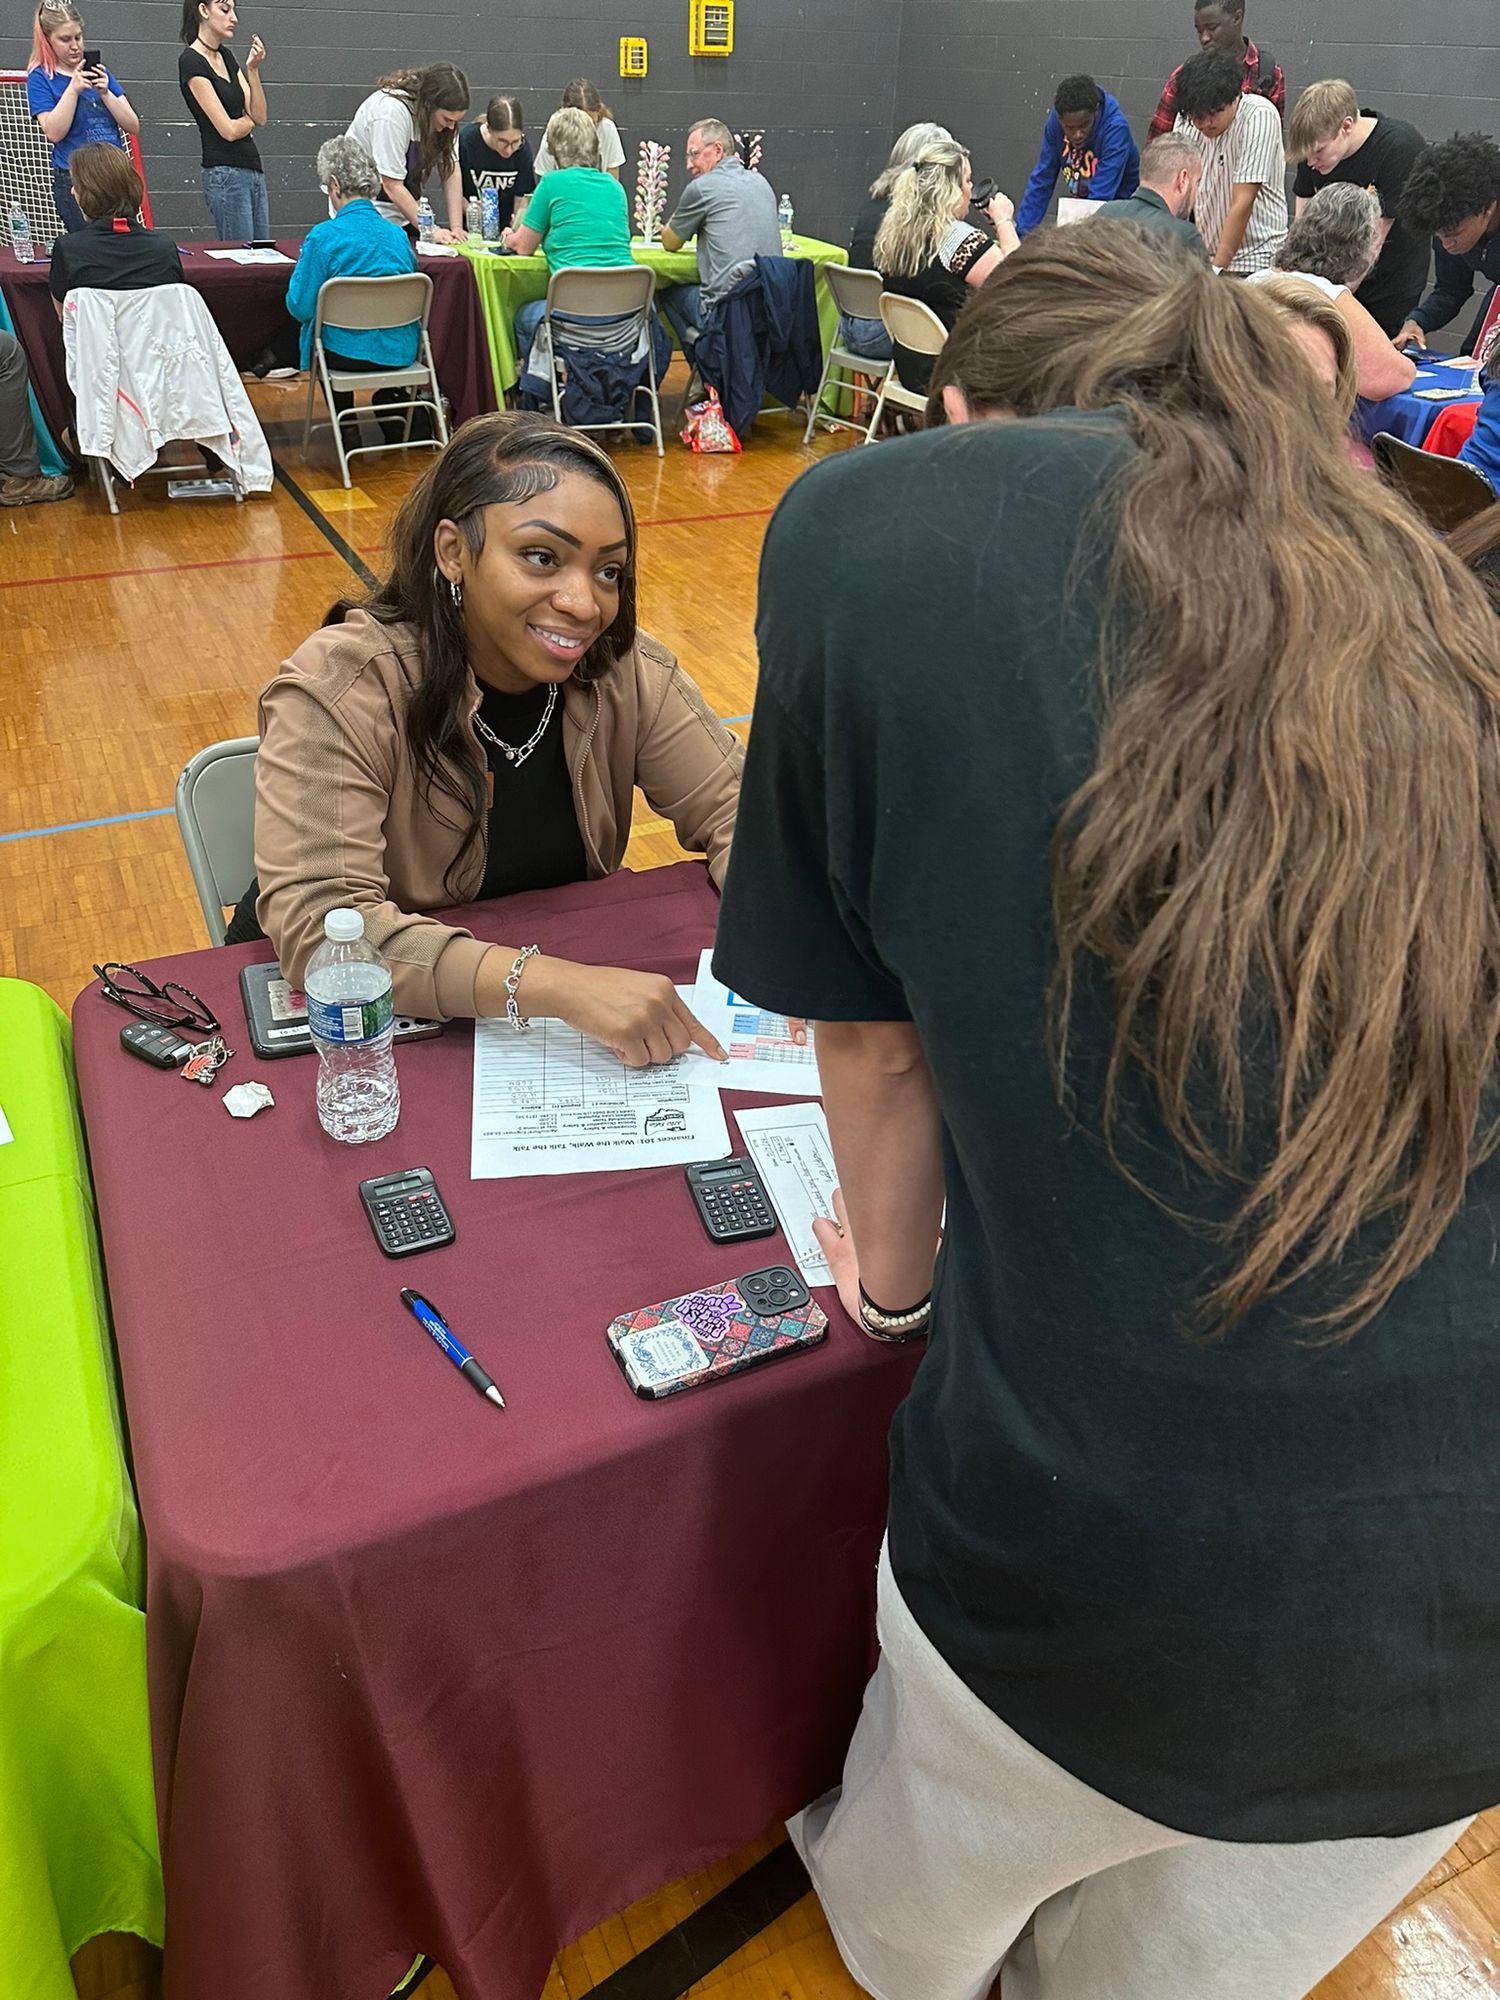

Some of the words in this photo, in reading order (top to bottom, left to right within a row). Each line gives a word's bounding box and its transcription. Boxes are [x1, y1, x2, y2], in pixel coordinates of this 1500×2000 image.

[470, 169, 518, 190] VANS
[569, 1141, 594, 1149] Walk,
[676, 1299, 710, 1315] Root
[682, 1310, 727, 1339] Stand
[701, 1310, 726, 1328] Beer
